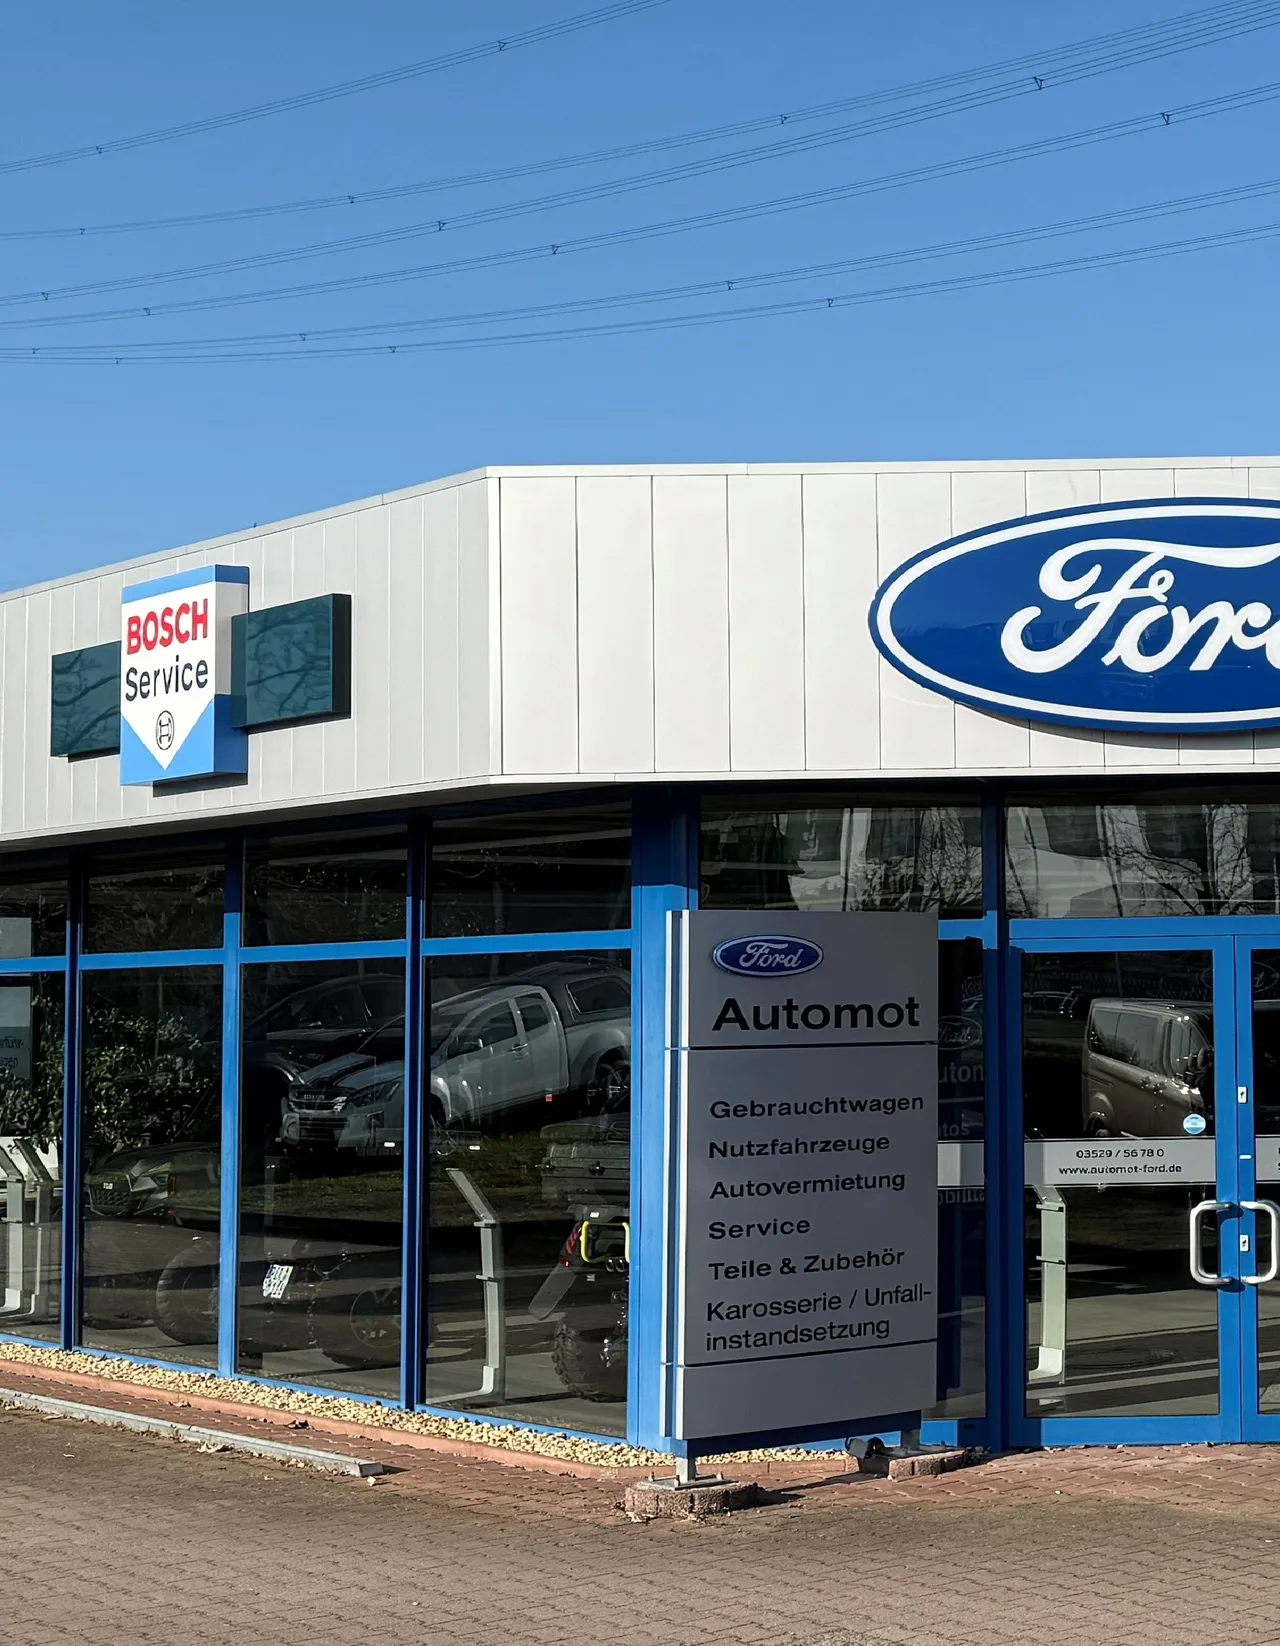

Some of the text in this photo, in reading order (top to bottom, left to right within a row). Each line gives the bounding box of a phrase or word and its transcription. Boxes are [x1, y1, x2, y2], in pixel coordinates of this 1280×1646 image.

[127, 598, 208, 655] BOSCH
[125, 655, 208, 702] Service
[739, 941, 804, 968] Ford
[712, 997, 920, 1031] Automot
[710, 1094, 925, 1120] Gebrauchtwagen
[709, 1134, 891, 1159] Nutzfahrzeuge
[1075, 1149, 1113, 1159] 03529
[1058, 1164, 1182, 1175] www.automot-ford.de
[710, 1172, 906, 1200] Autovermietung
[708, 1217, 811, 1240] Service
[709, 1248, 906, 1281] Teile & Zubehör
[707, 1283, 932, 1322] Karosserie / Unfall-
[706, 1317, 891, 1352] instandsetzung
